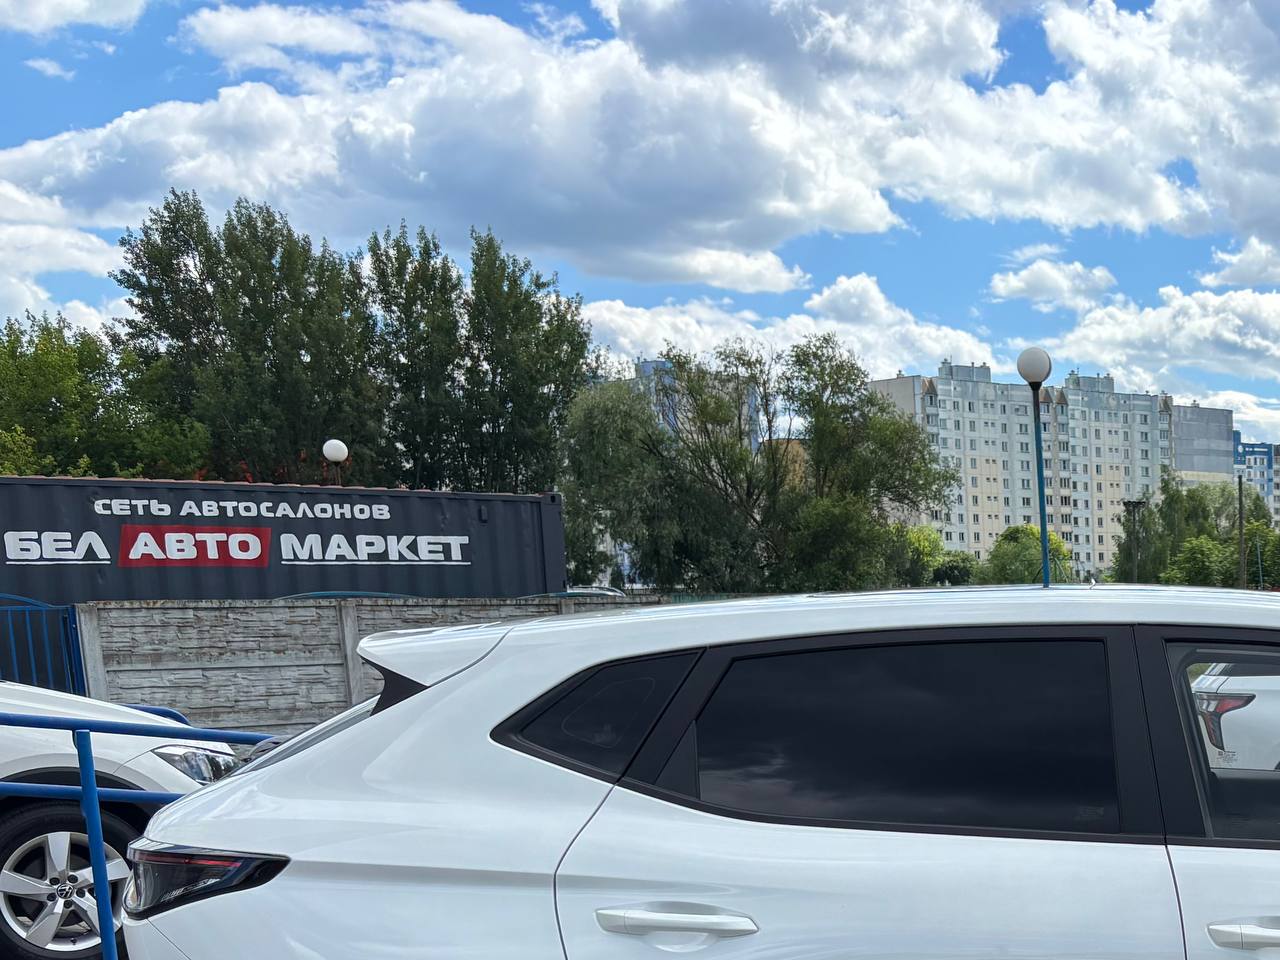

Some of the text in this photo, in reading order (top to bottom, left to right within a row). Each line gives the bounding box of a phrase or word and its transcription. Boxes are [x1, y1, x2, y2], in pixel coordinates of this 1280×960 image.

[94, 499, 391, 520] СЕТЬ АВТОСАЛОНОВ
[4, 531, 470, 561] БЕЛ АВТО МАРКЕТ
